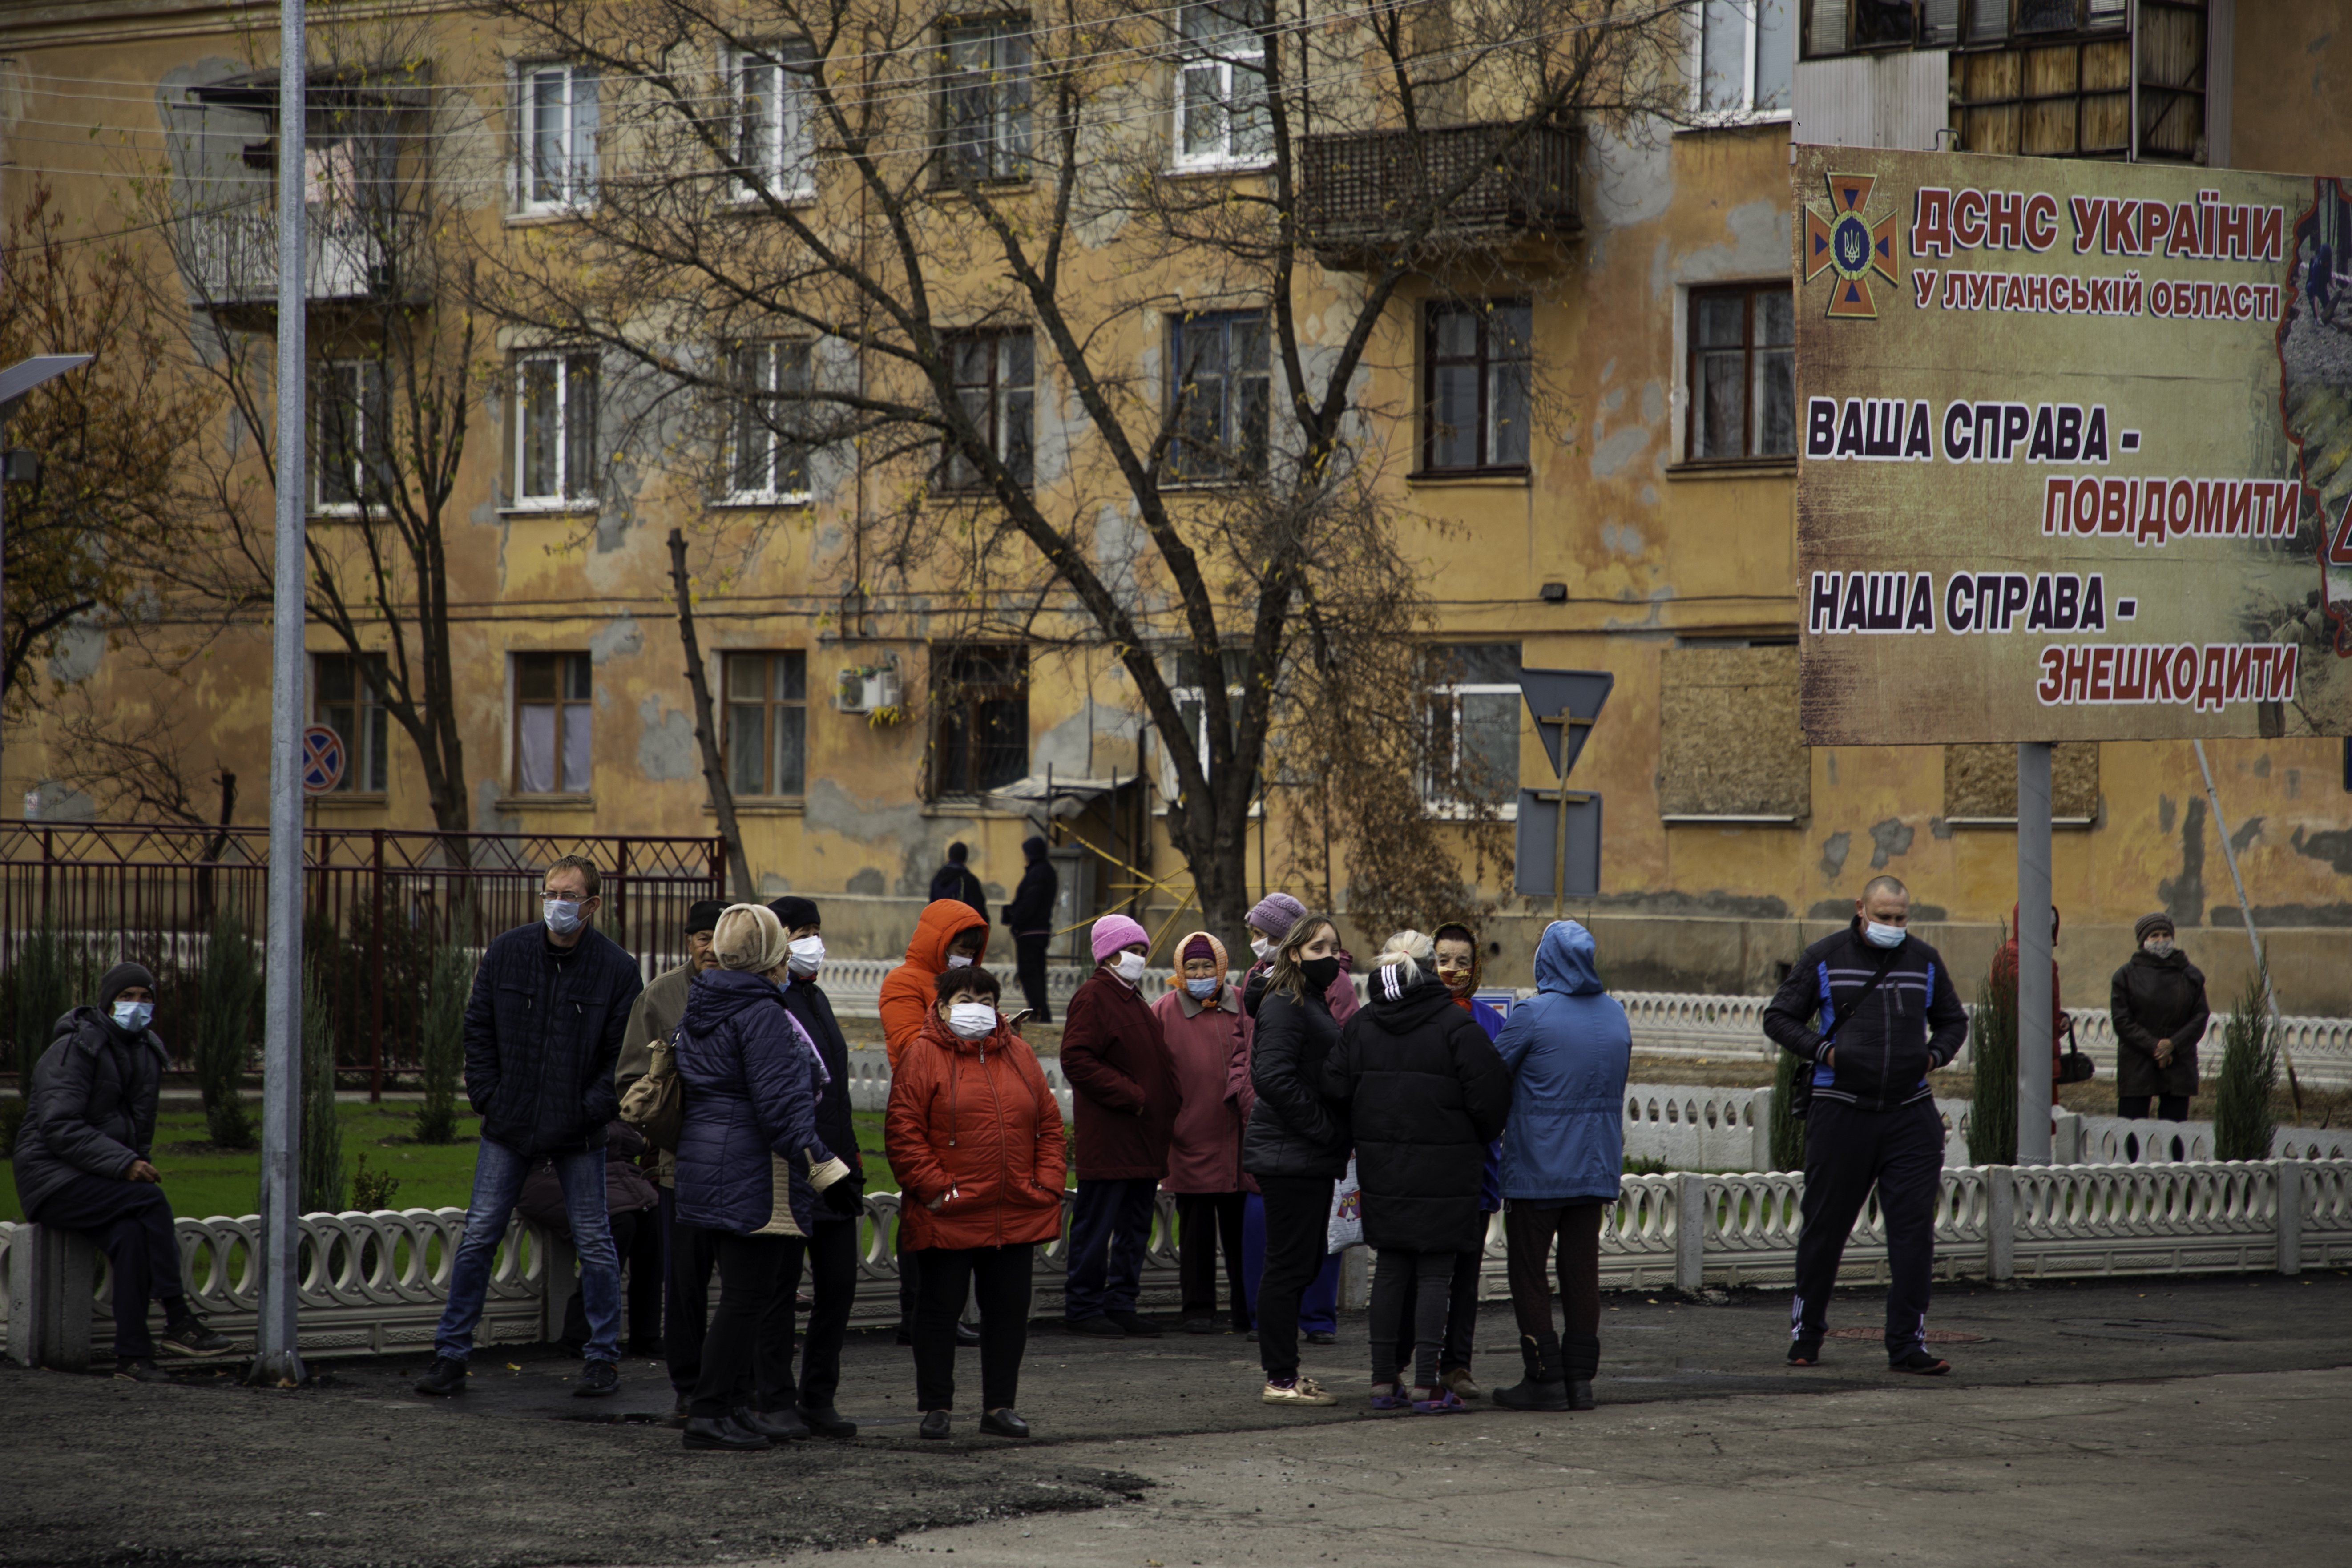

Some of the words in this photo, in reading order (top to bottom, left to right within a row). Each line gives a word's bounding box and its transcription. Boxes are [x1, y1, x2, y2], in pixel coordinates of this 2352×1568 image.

[1915, 189, 2057, 254] ДСНС
[2074, 192, 2281, 258] УКРАЇНИ
[1915, 271, 1936, 306] У
[1944, 272, 2141, 313] ЛУГАНСЬКІЙ
[2152, 282, 2279, 319] ОБЛАСТІ
[1808, 399, 1932, 460] ВАША
[1944, 400, 2107, 463] СПРАВА
[2043, 477, 2299, 545] ПОВІДОМИТИ
[1811, 573, 1934, 632] НАША
[1946, 573, 2105, 632] СПРАВА
[2039, 645, 2297, 710] ЗНЕШКОДИТИ
